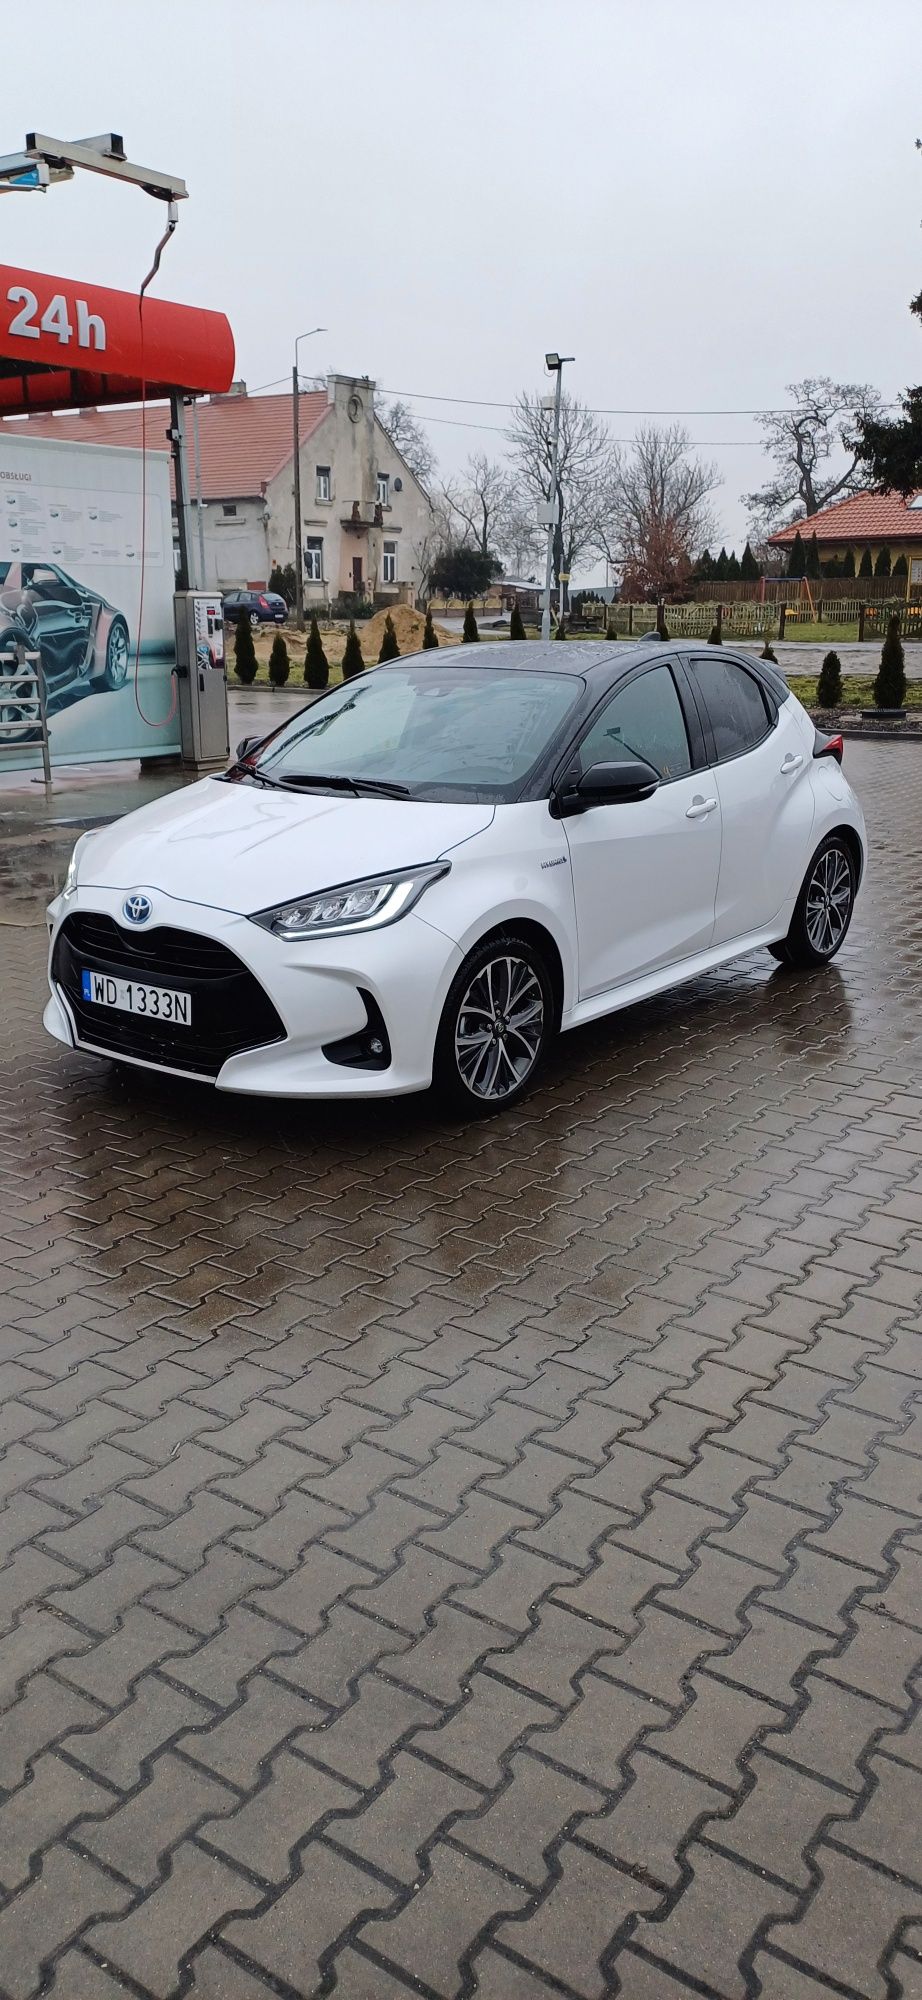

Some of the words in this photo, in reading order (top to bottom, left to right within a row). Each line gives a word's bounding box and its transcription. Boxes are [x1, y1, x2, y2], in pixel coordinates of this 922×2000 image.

[6, 286, 106, 351] 24h
[94, 975, 117, 1004] WD
[126, 984, 187, 1022] 1333N
